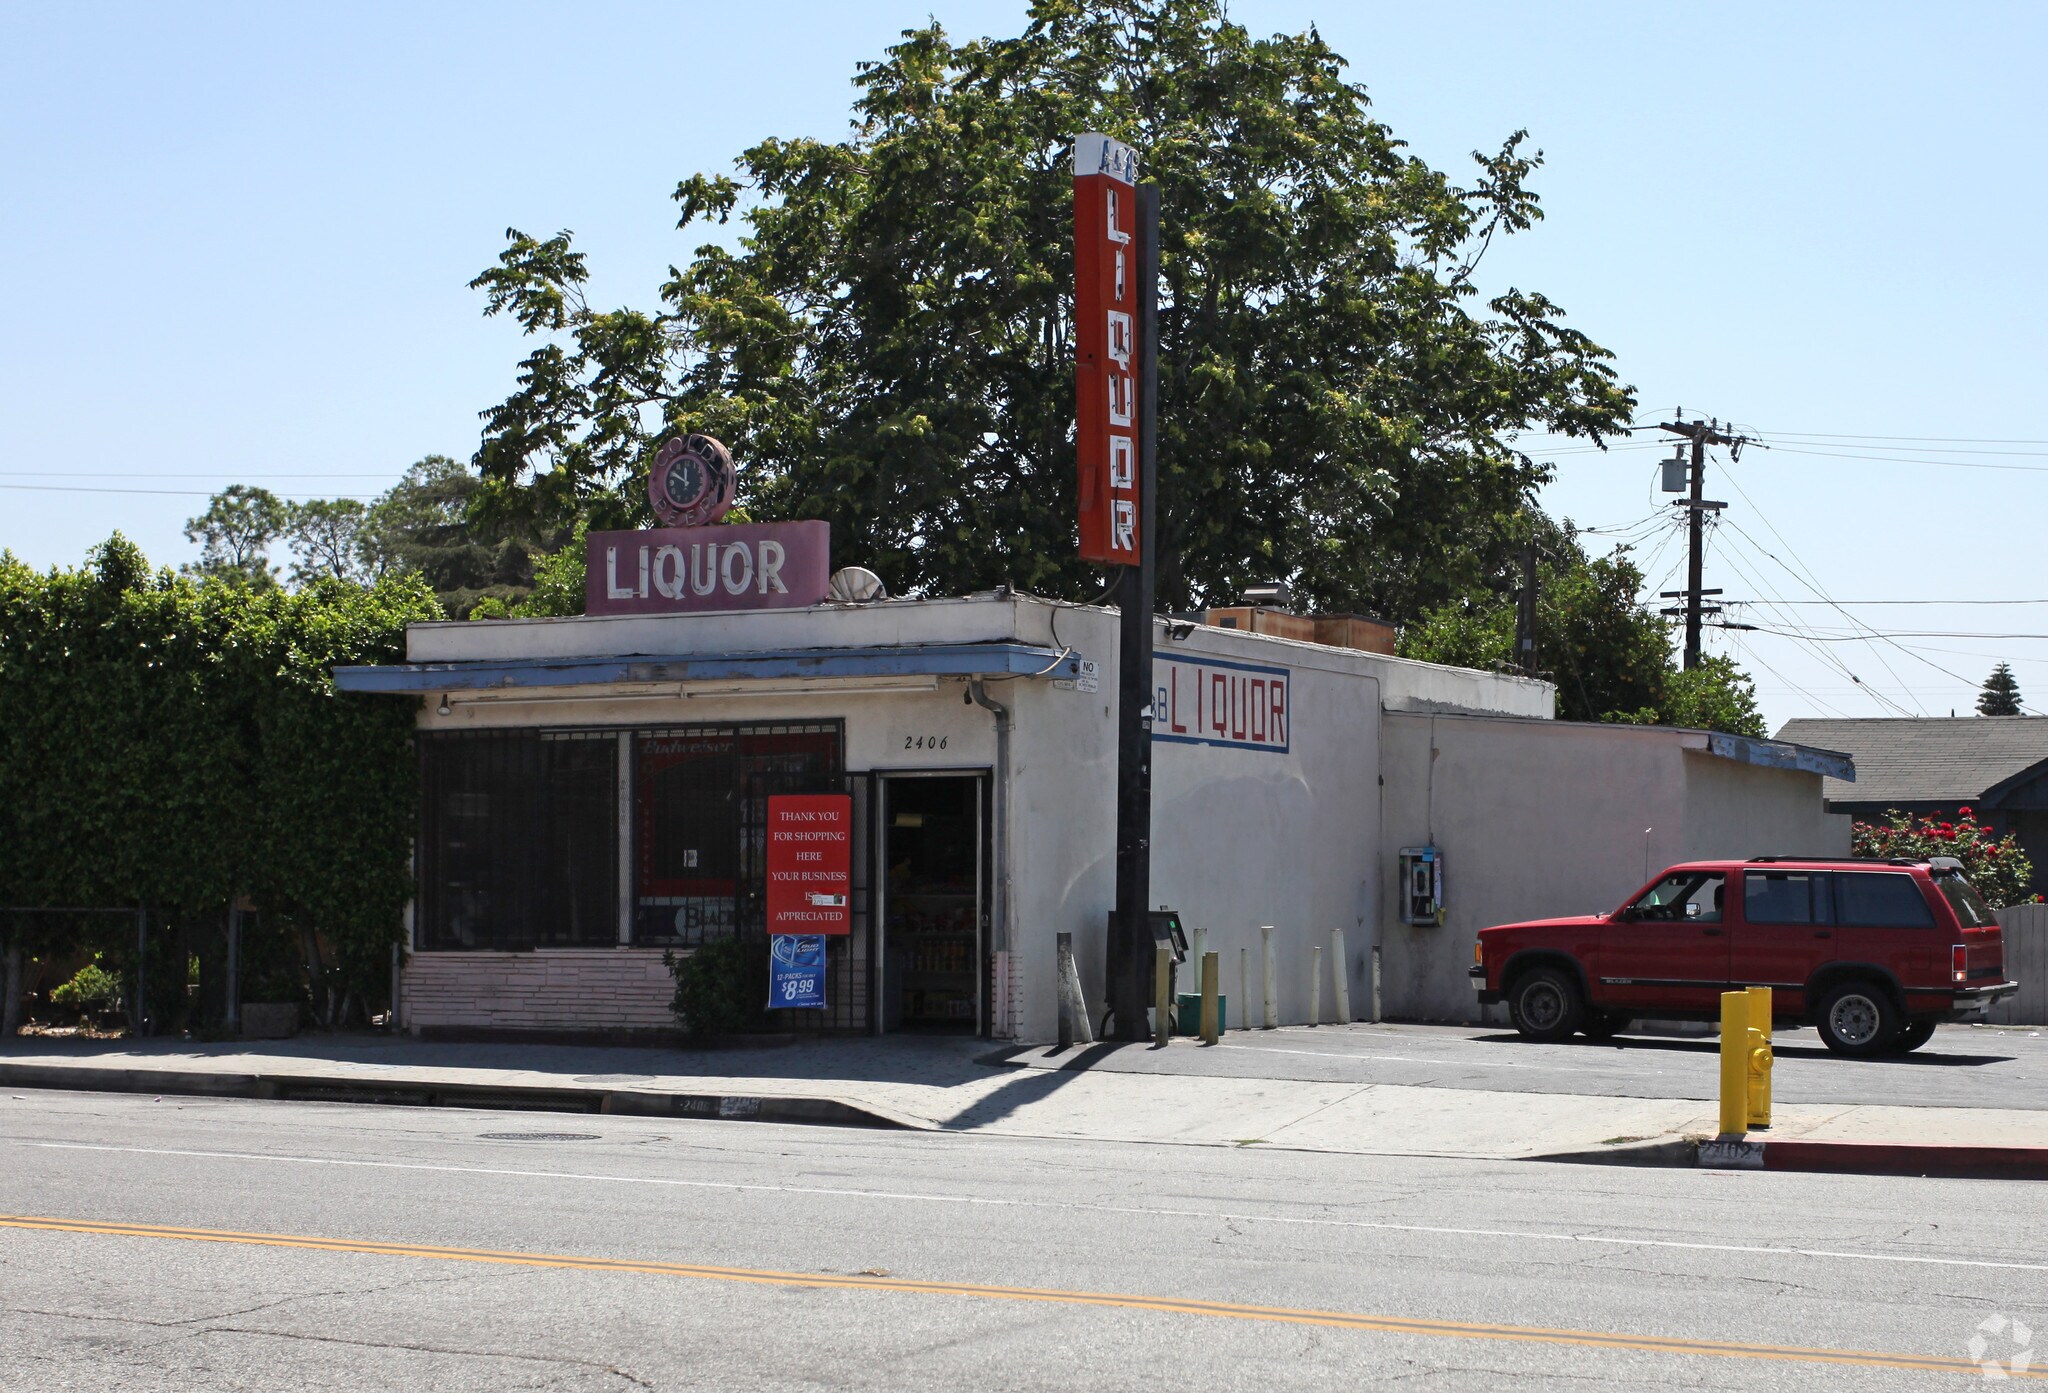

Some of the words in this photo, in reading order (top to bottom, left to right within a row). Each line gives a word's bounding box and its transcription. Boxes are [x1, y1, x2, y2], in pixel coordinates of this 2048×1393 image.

[1106, 187, 1137, 551] LIQUOR
[606, 540, 789, 600] LIQUOR
[1083, 661, 1094, 672] NO
[1172, 667, 1285, 743] LIQUOR
[905, 736, 948, 750] 2406
[780, 811, 816, 821] THANK
[818, 811, 839, 821] YOU
[774, 832, 794, 842] FOR
[795, 831, 846, 842] SHOPPING
[796, 851, 822, 861] HERE
[772, 872, 800, 881] YOUR
[801, 871, 847, 881] BUSINESS
[805, 891, 813, 901] IS
[776, 911, 843, 921] APPRECIATED
[781, 979, 814, 1000] $8.99
